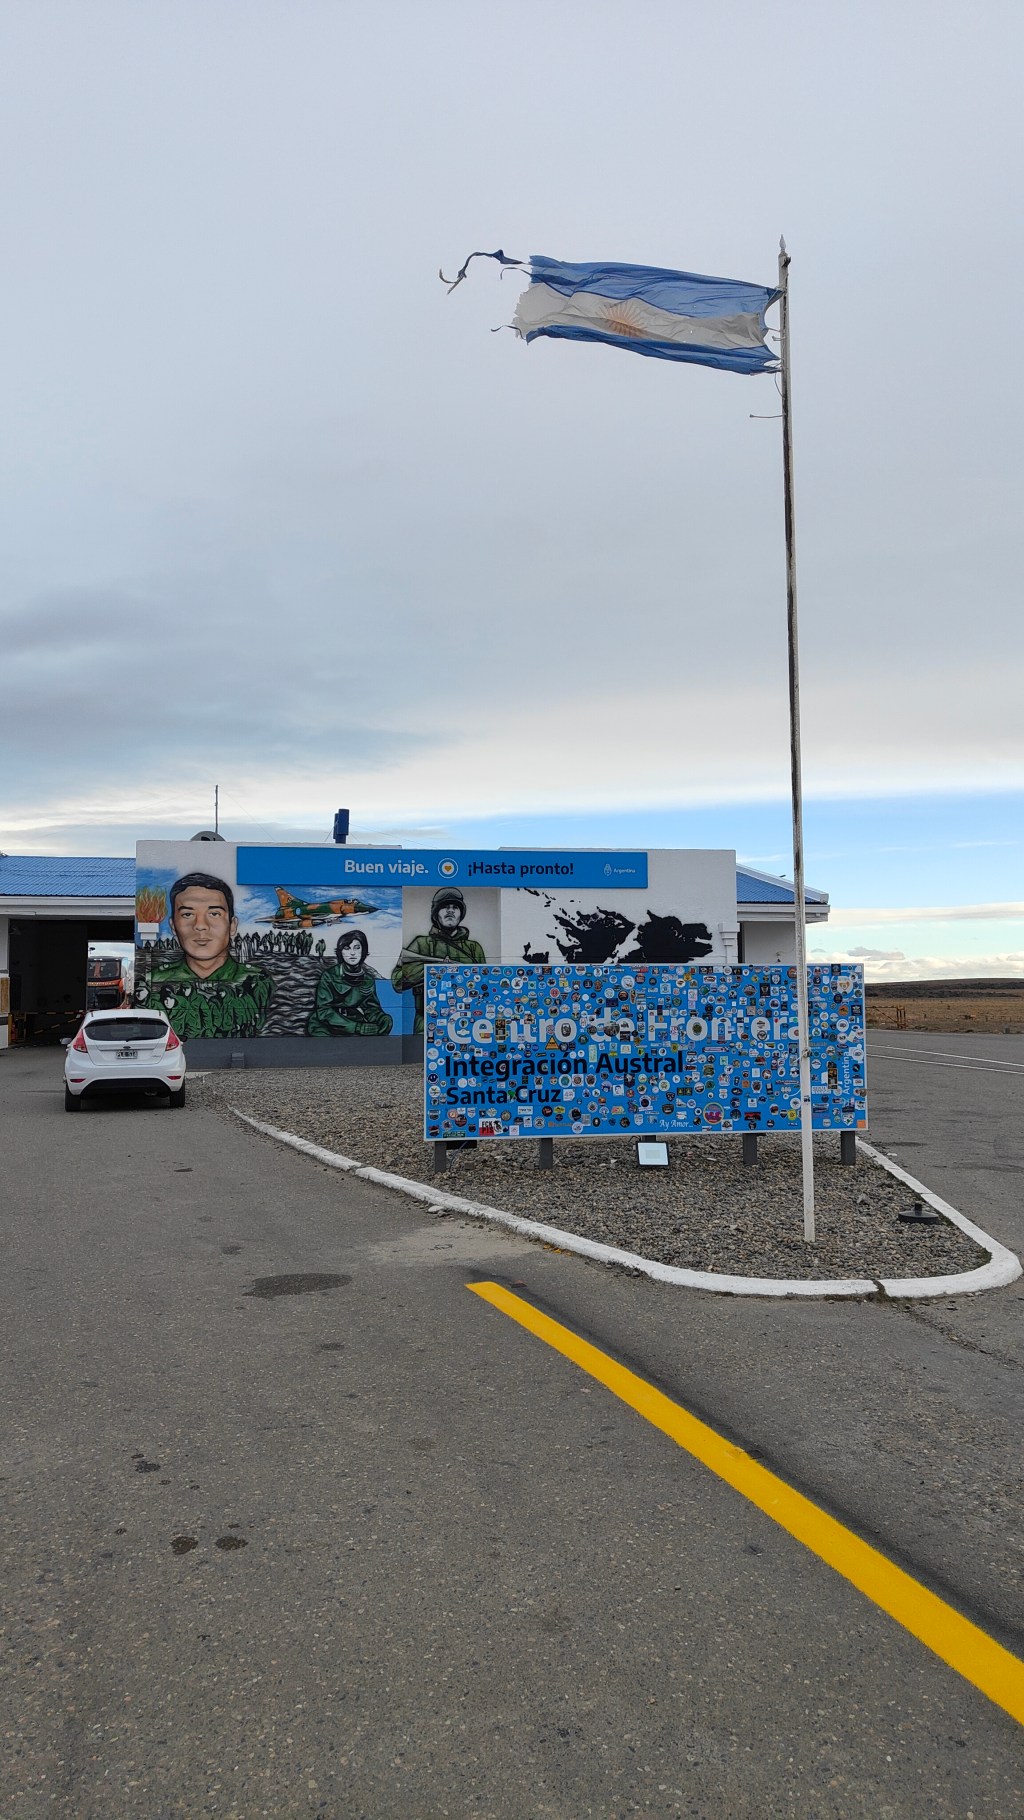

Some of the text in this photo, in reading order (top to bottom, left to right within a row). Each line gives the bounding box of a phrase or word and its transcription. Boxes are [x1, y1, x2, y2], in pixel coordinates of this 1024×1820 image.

[344, 859, 429, 877] Buen viaje.
[468, 861, 574, 877] ¡Hasta pronto!
[447, 1011, 577, 1044] Centro
[589, 1007, 635, 1042] de
[445, 1051, 684, 1082] Integración Austral
[842, 1052, 852, 1095] Argentina
[446, 1086, 562, 1105] Santa Cruz
